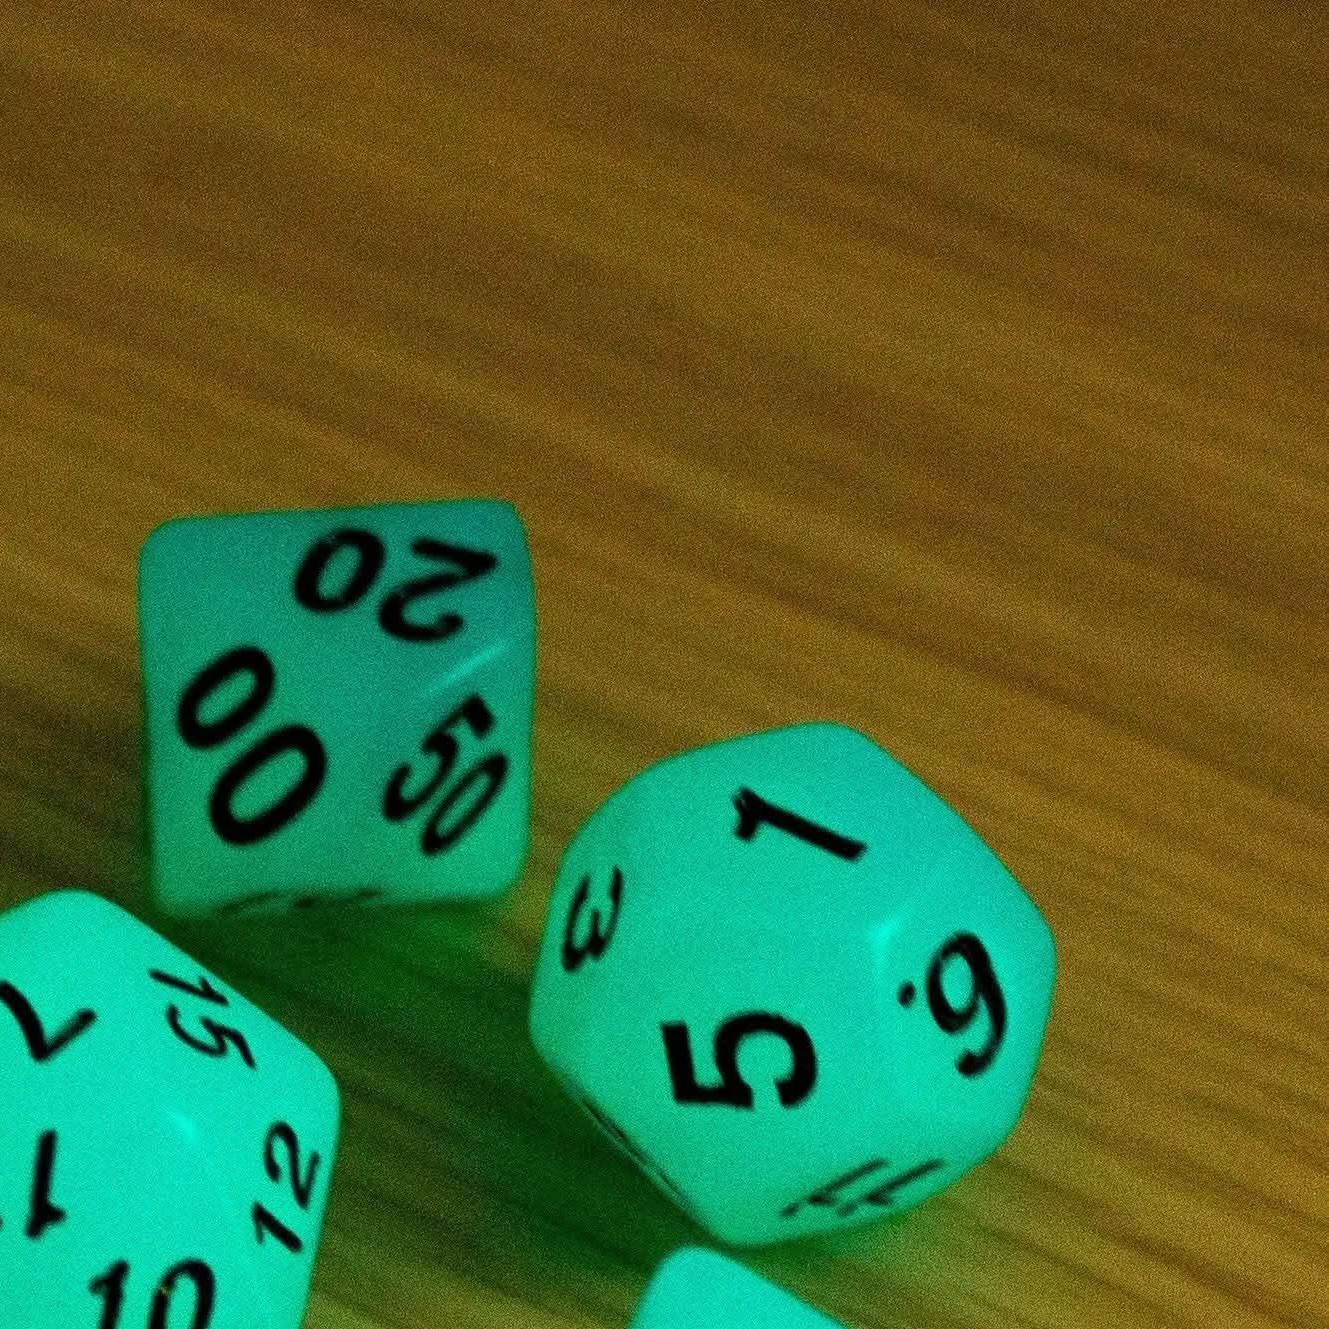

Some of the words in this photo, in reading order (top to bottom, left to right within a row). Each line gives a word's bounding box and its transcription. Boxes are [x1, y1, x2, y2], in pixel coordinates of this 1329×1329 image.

[292, 526, 499, 644] 20
[175, 645, 328, 847] 00
[381, 693, 509, 857] 50
[733, 787, 867, 862] 1
[561, 867, 623, 973] 3
[149, 967, 256, 1070] 15
[660, 1011, 817, 1110] 5
[252, 1121, 321, 1254] 12
